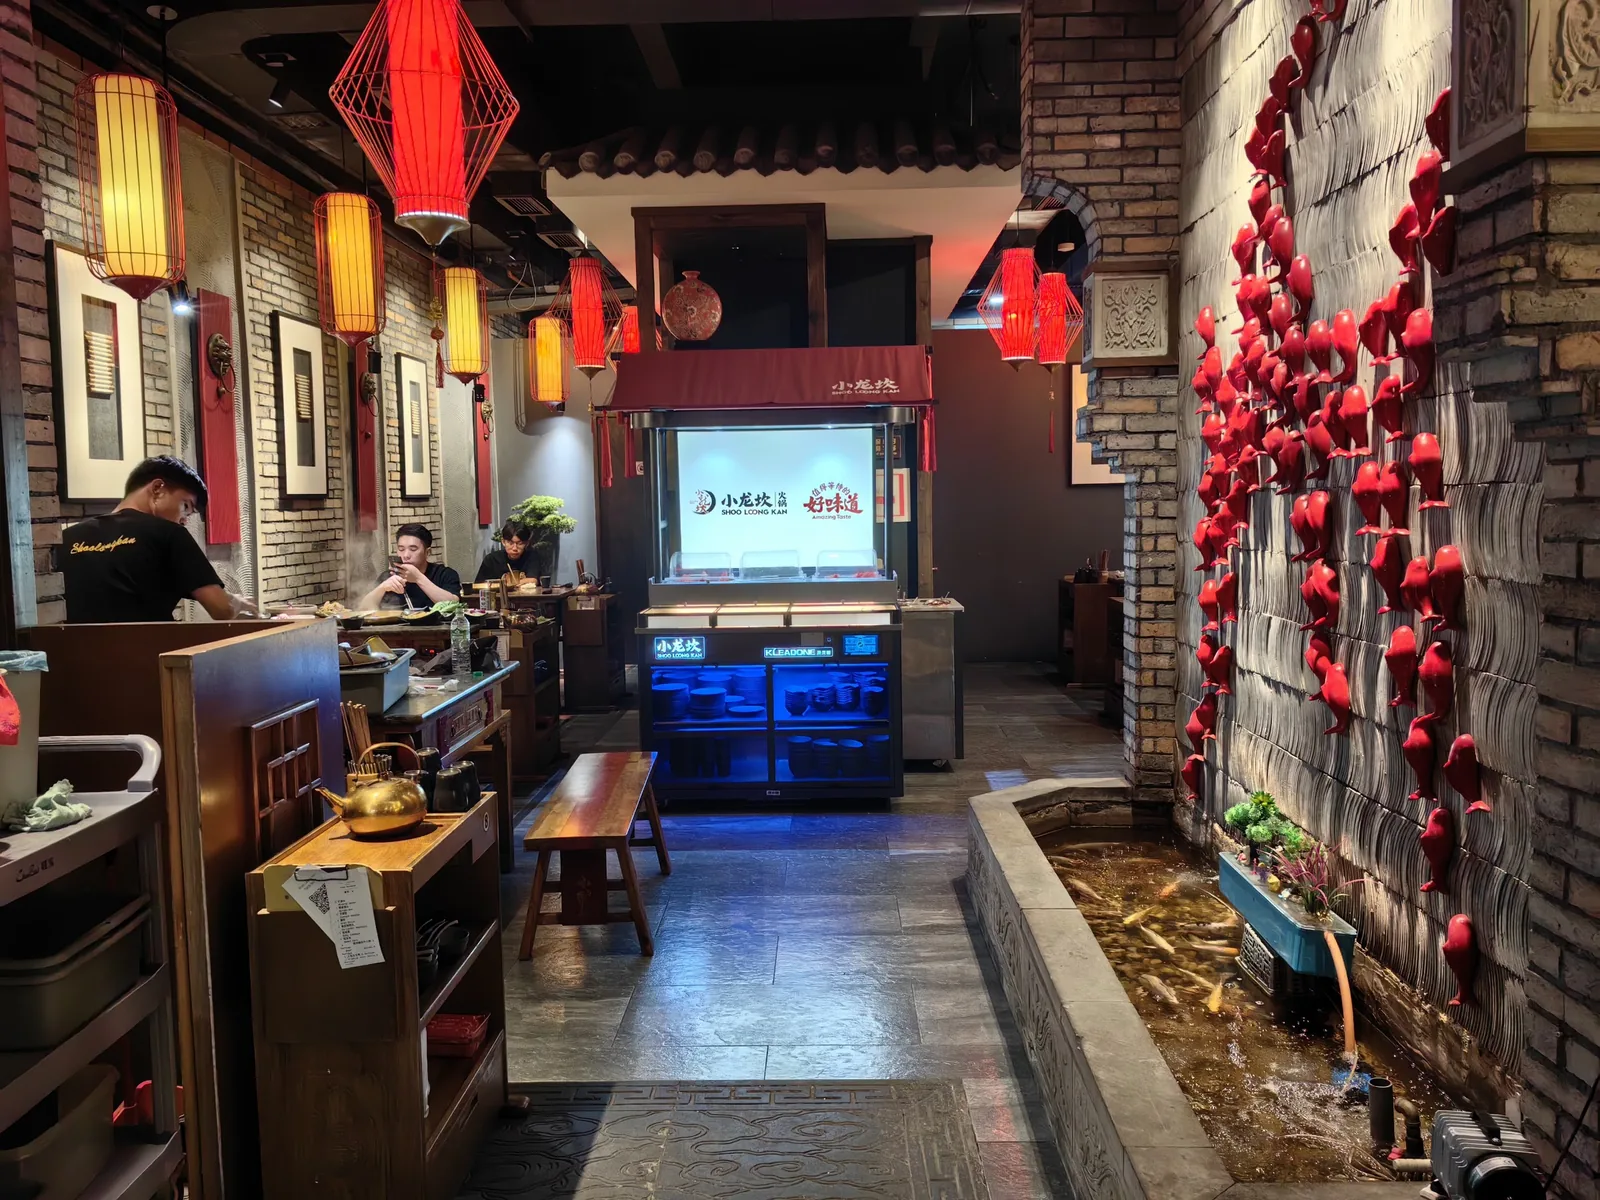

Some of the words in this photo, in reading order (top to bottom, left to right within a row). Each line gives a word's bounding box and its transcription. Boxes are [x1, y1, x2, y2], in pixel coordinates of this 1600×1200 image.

[831, 378, 899, 390] 小龙坎
[721, 492, 773, 508] 小龙坎
[778, 492, 788, 508] 火锅
[803, 492, 863, 514] 好味道
[657, 638, 702, 652] 小龙坎
